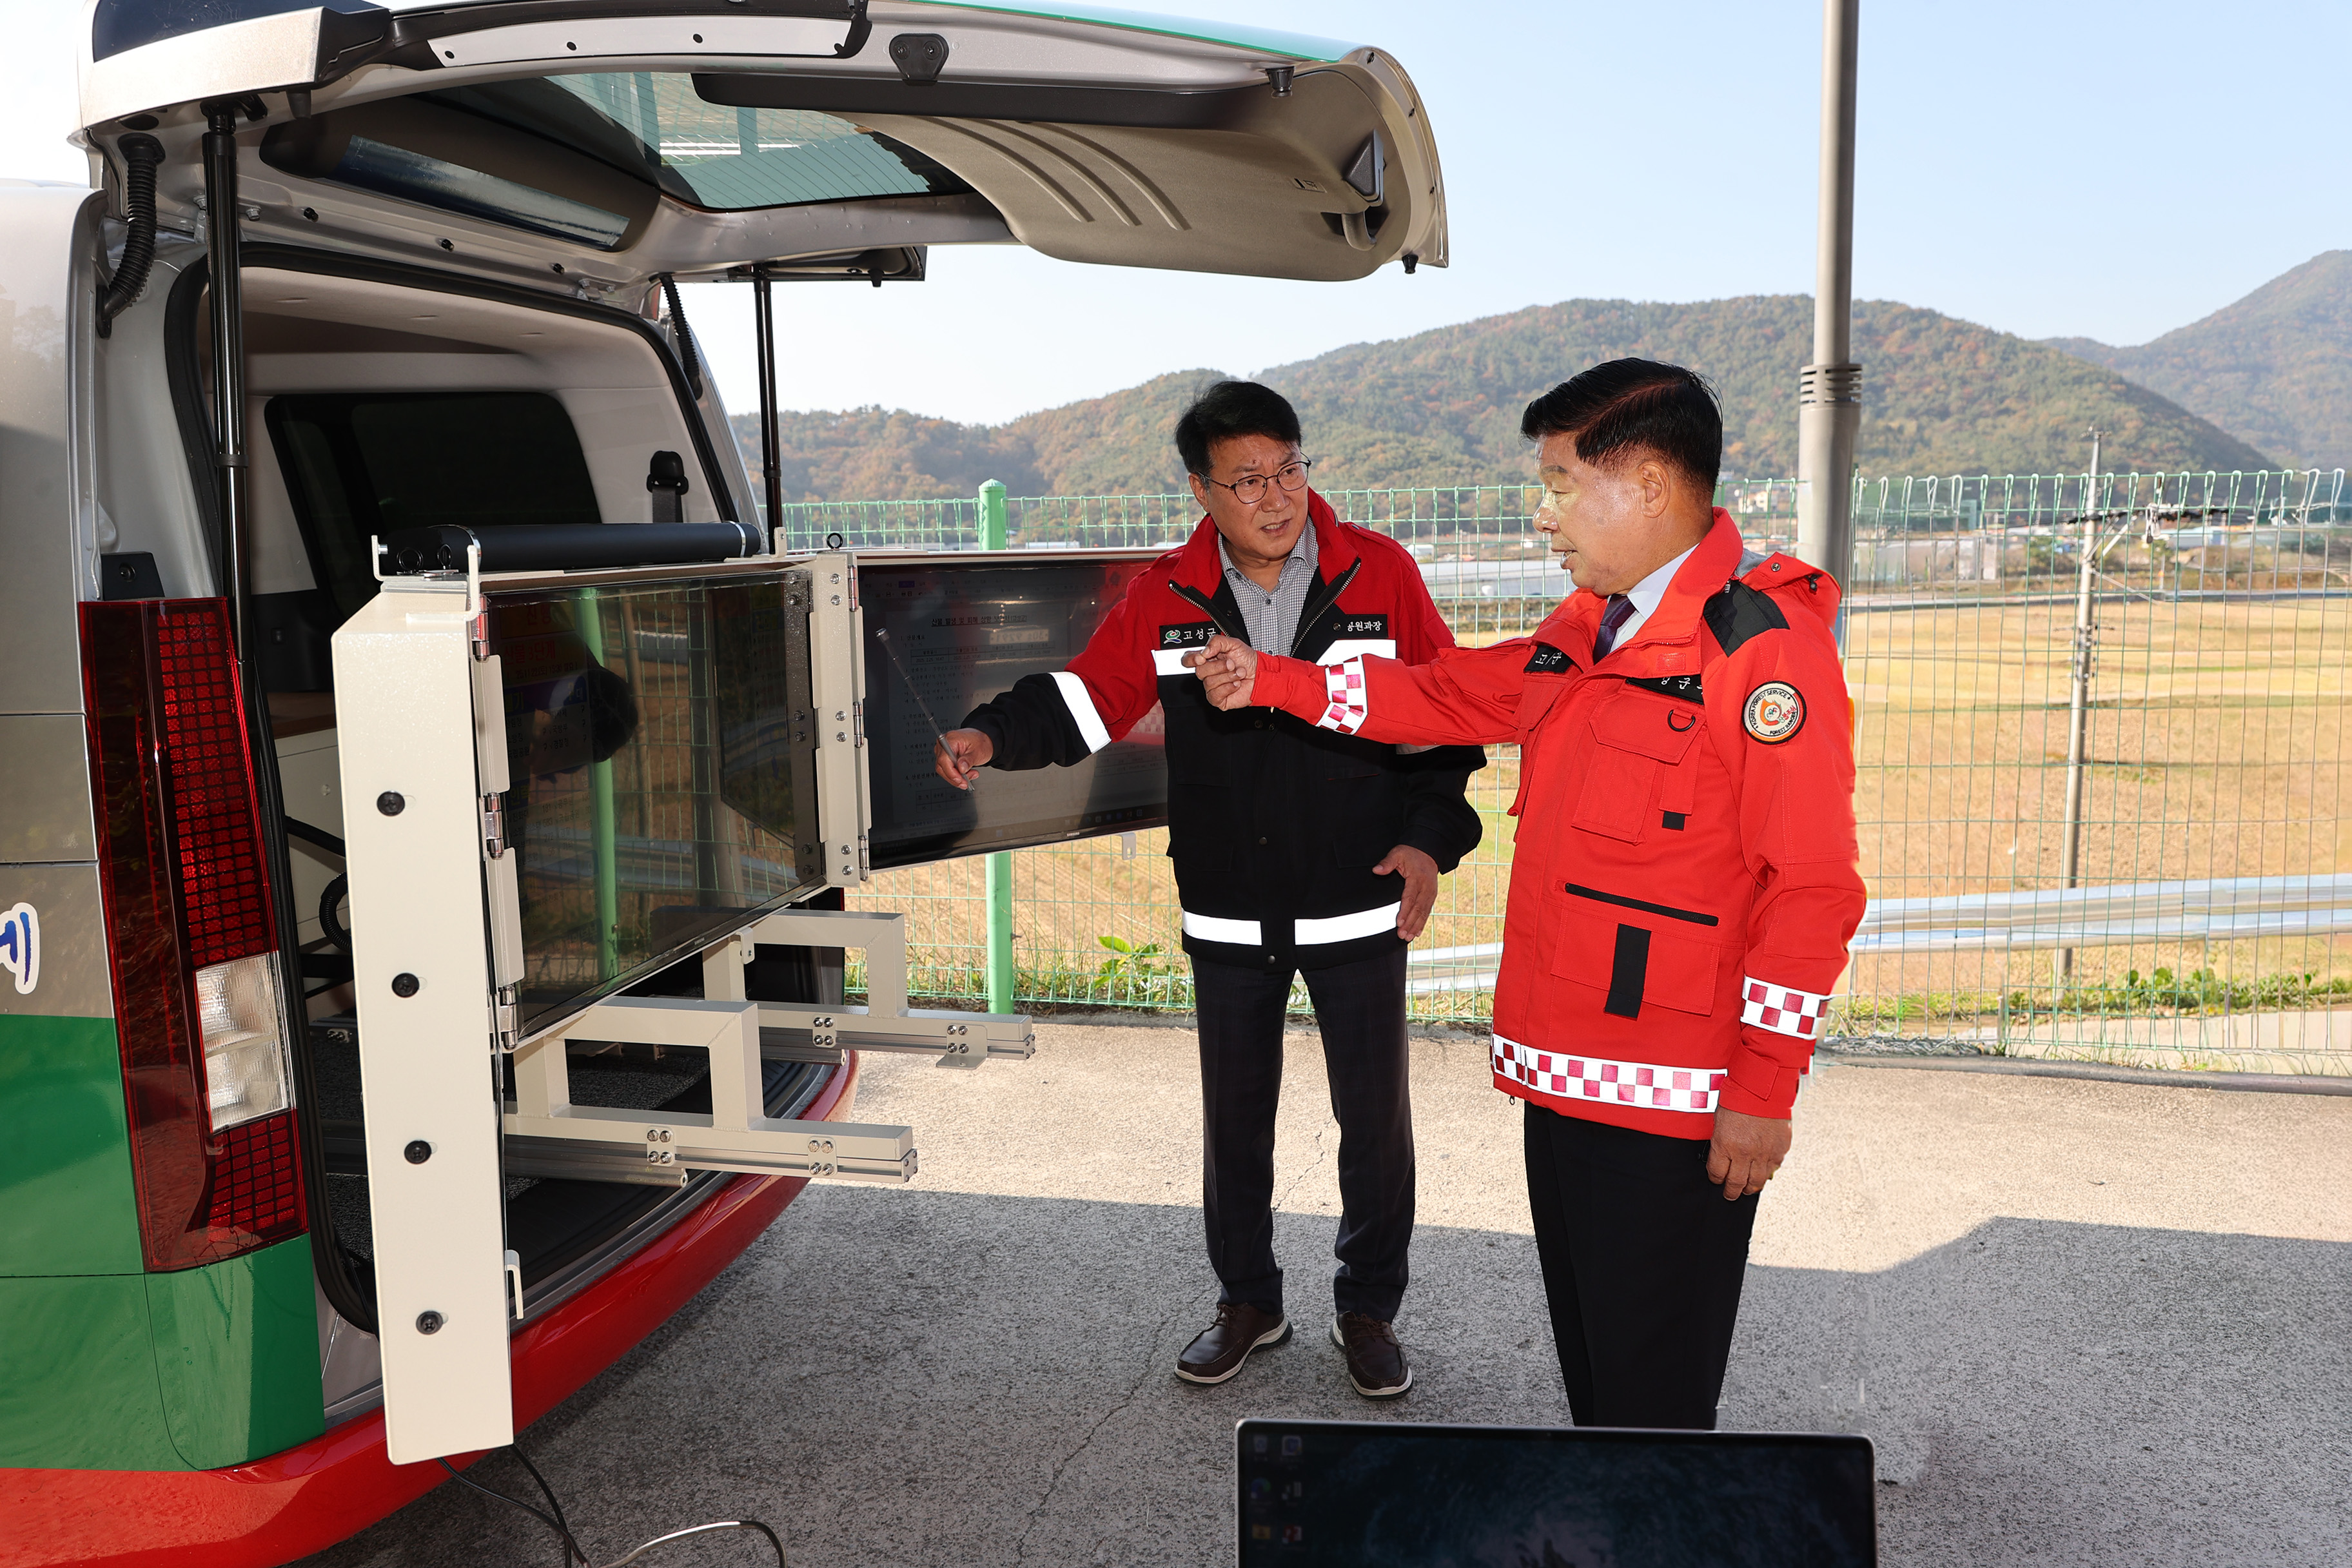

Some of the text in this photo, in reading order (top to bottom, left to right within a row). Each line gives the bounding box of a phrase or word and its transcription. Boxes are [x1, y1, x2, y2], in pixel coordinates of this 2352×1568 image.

[1183, 627, 1217, 640] 고성군
[1347, 620, 1382, 632] 공원과장
[1752, 692, 1767, 709] FOREST
[1767, 689, 1788, 698] SERVICE
[1769, 711, 1797, 735] FOREST RANGER
